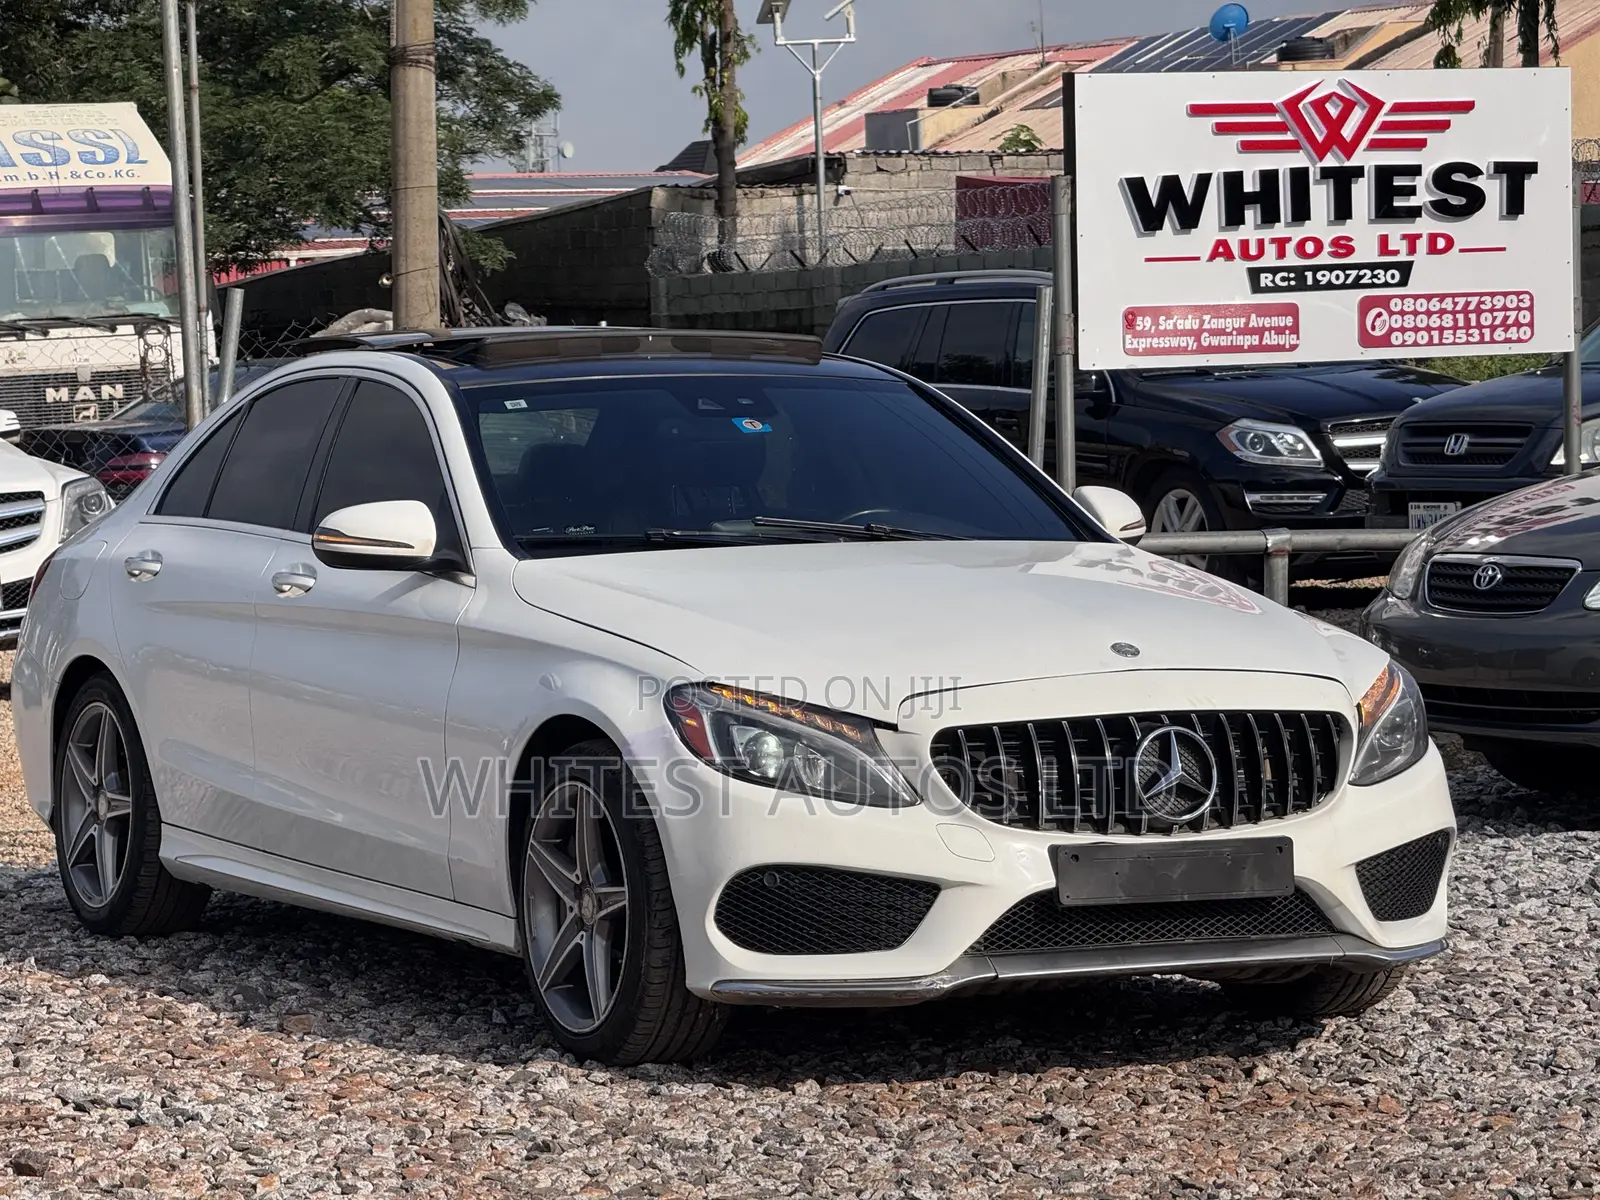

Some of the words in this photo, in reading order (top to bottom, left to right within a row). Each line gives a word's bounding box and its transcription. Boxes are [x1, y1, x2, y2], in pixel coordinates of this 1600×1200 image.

[1117, 160, 1538, 237] WHITEST
[1206, 235, 1356, 262] AUTOS
[1377, 232, 1455, 258] LTD
[1260, 271, 1296, 288] RC:
[1305, 269, 1400, 286] 1907230
[1389, 293, 1531, 312] 08064773903
[1135, 315, 1156, 333] 59,
[1202, 314, 1246, 332] Zangur
[1248, 313, 1294, 329] Avenue
[1390, 309, 1531, 329] 08068110770
[1125, 333, 1197, 352] Expressway,
[1201, 330, 1259, 350] Gwarinpa
[1262, 329, 1300, 349] Abuja.
[1390, 325, 1532, 346] 09015531640
[45, 383, 124, 403] MAN
